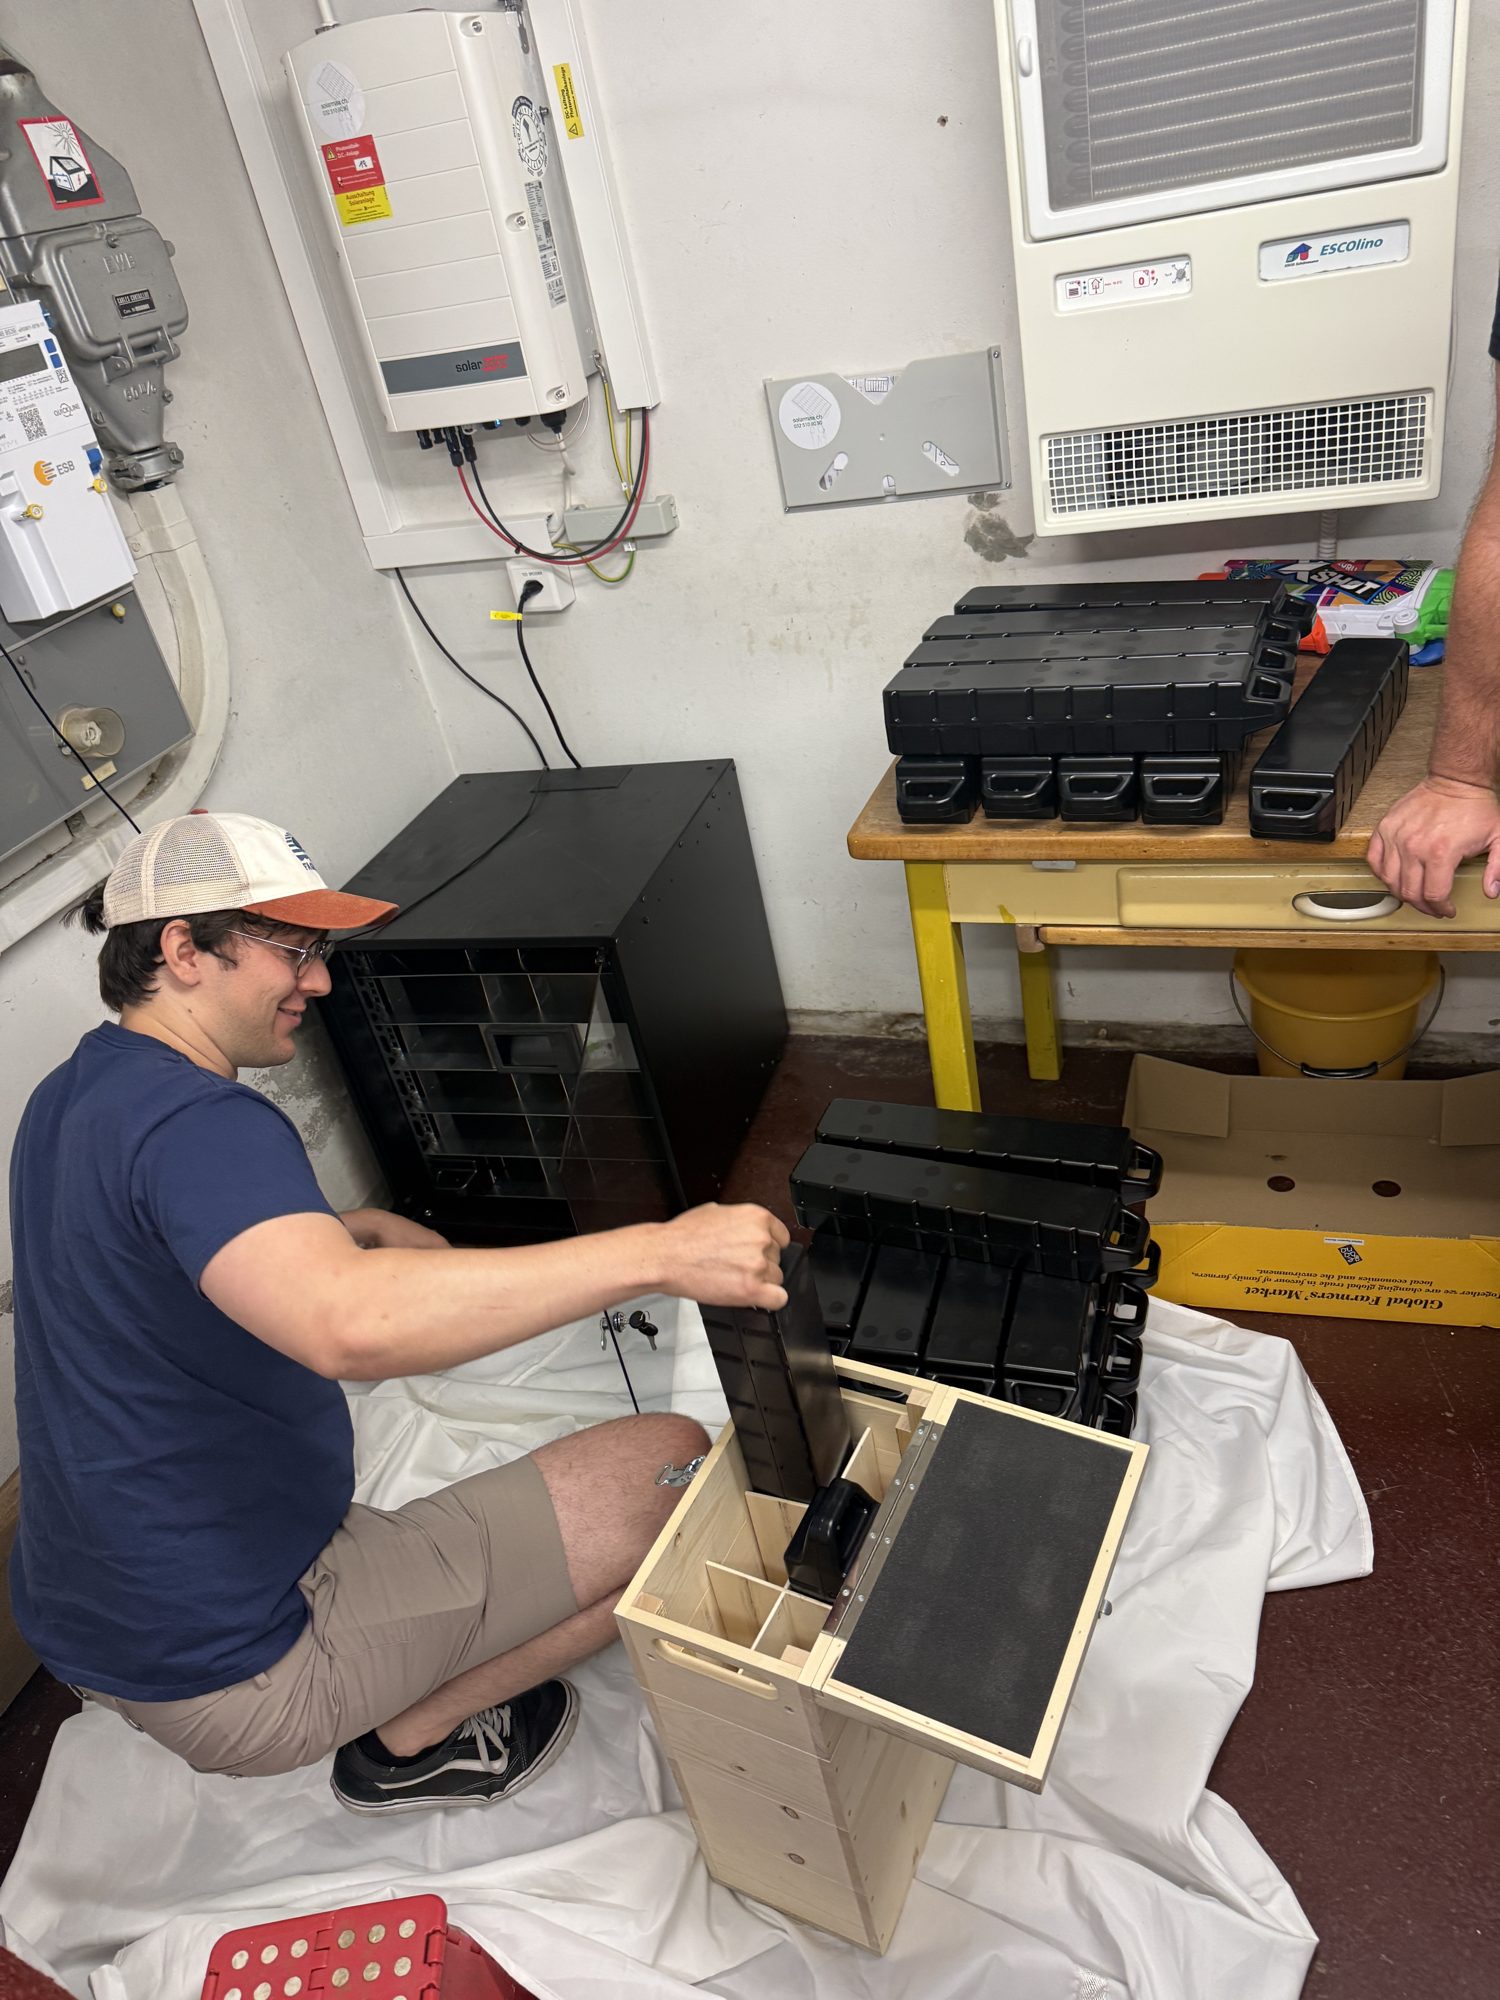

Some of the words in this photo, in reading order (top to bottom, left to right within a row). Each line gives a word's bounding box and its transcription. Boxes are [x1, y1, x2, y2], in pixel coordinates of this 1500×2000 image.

[1320, 238, 1384, 256] ESCOlino
[56, 460, 76, 476] ESB
[1310, 570, 1381, 594] SHOT
[1232, 1273, 1260, 1283] family
[1263, 1276, 1272, 1284] of
[1274, 1278, 1306, 1286] favour
[1359, 1275, 1408, 1284] economies
[1409, 1279, 1433, 1287] local
[1319, 1281, 1344, 1289] trade
[1347, 1282, 1377, 1292] global
[1378, 1284, 1422, 1293] changing
[1244, 1286, 1303, 1300] Market
[1386, 1296, 1443, 1310] Global
